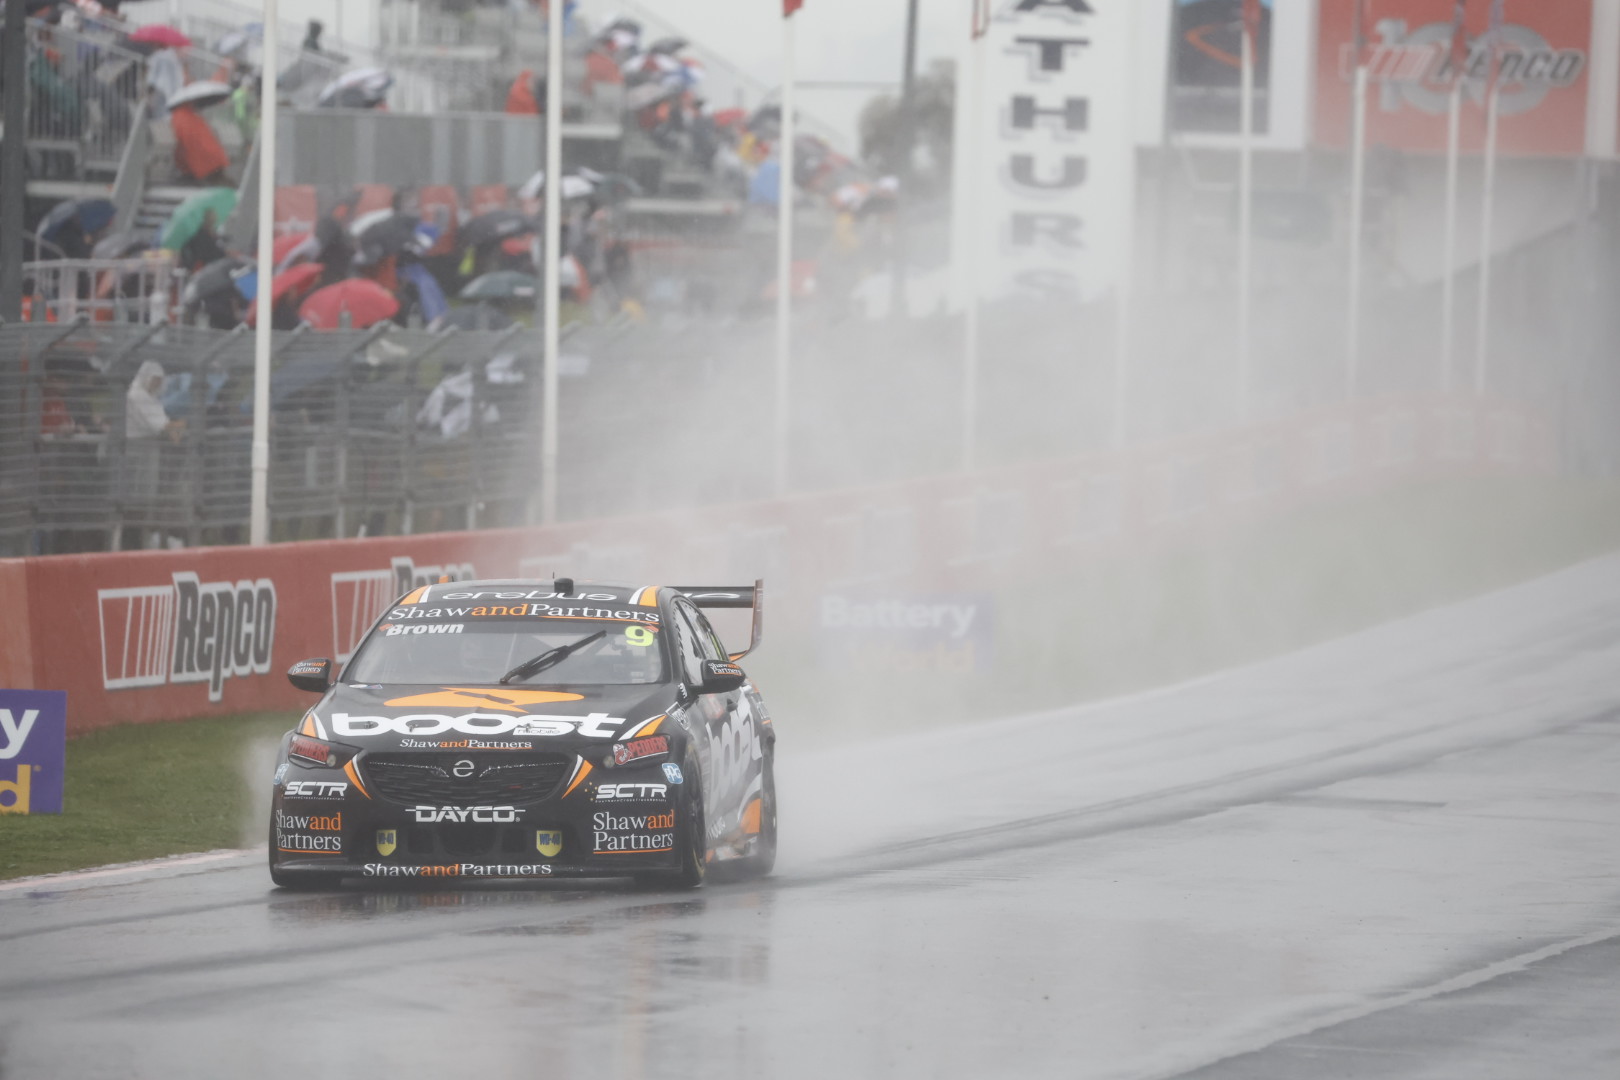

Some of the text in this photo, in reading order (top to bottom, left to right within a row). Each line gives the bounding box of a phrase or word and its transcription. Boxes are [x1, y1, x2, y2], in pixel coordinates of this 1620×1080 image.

[442, 590, 617, 601] erebus
[820, 594, 977, 638] Battery
[170, 571, 277, 702] Repco
[385, 623, 465, 636] Brown
[625, 625, 654, 647] 9
[331, 712, 627, 738] boost
[284, 781, 348, 797] SCTR
[595, 783, 668, 799] SCTR
[414, 805, 516, 823] DAYCO
[276, 828, 342, 850] Partners
[593, 831, 674, 851] Partners
